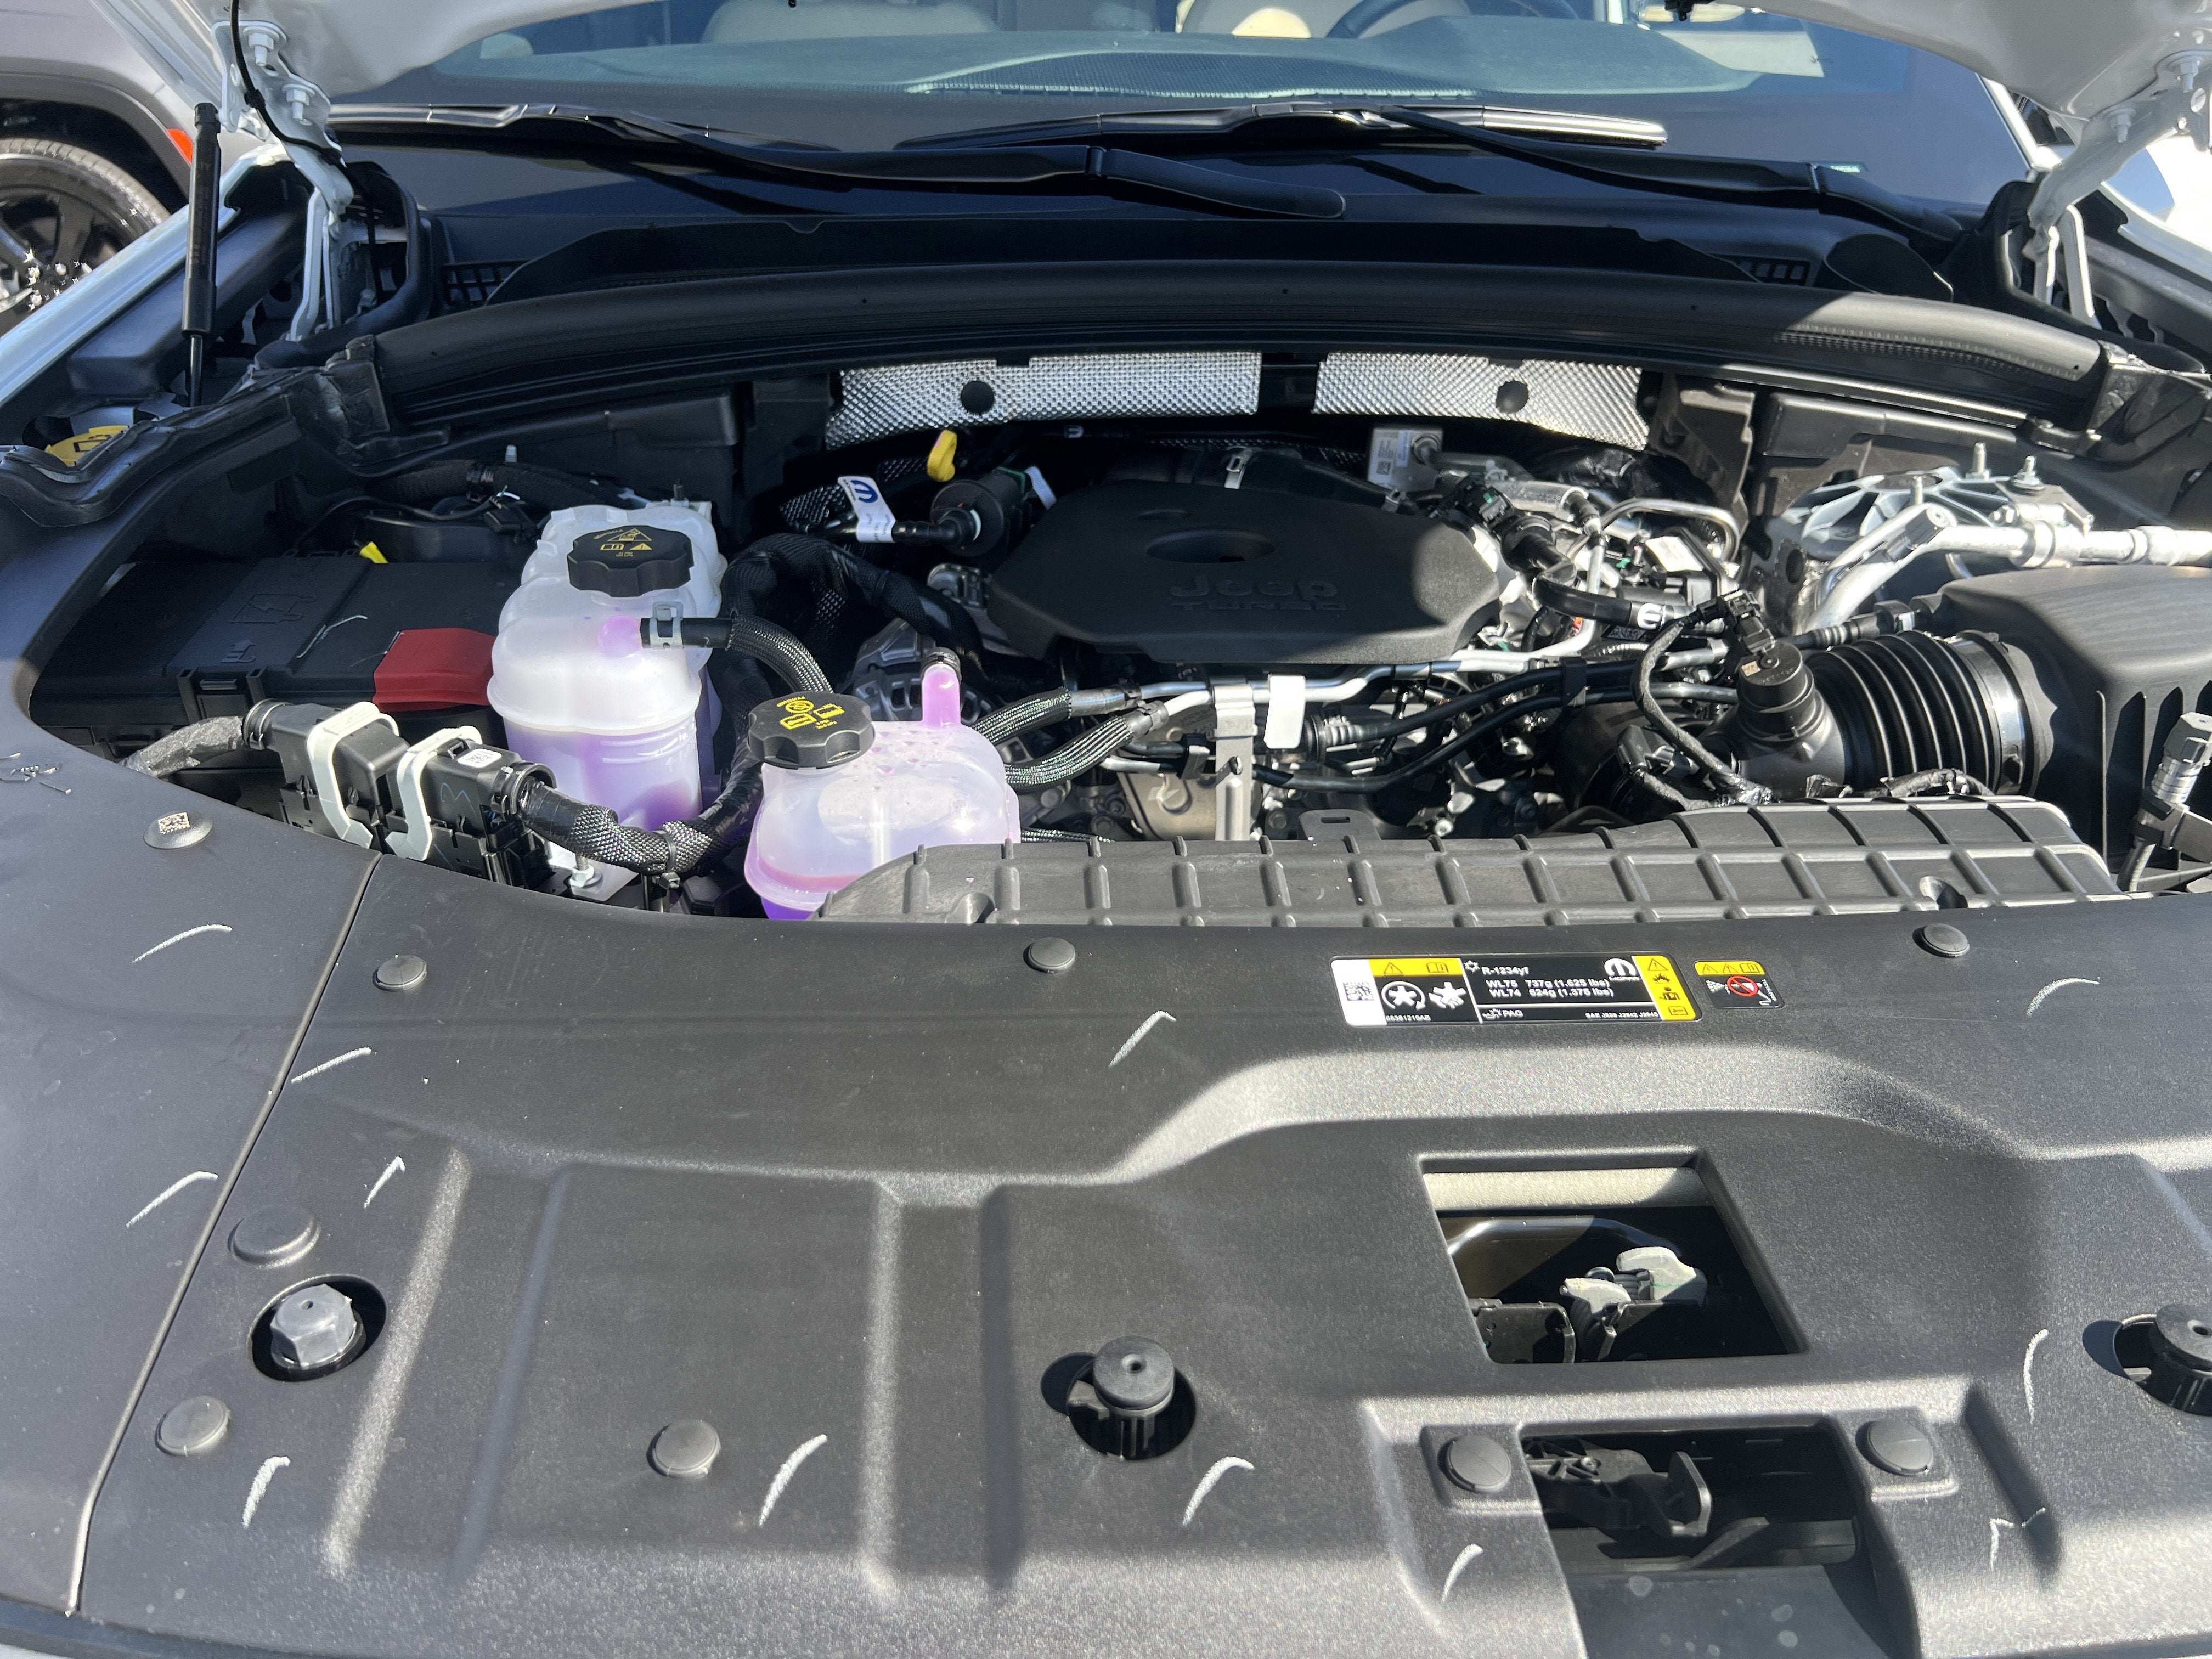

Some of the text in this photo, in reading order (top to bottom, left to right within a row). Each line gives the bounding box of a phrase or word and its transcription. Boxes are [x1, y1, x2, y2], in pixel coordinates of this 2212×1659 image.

[1169, 575, 1338, 601] Jeep
[1481, 966, 1529, 977] R-1234yf
[1486, 979, 1610, 989] WL75 737g (1.625 lbs)
[1488, 988, 1614, 998] WL74 624g (1.375 lbs)
[1502, 1009, 1523, 1018] PAG
